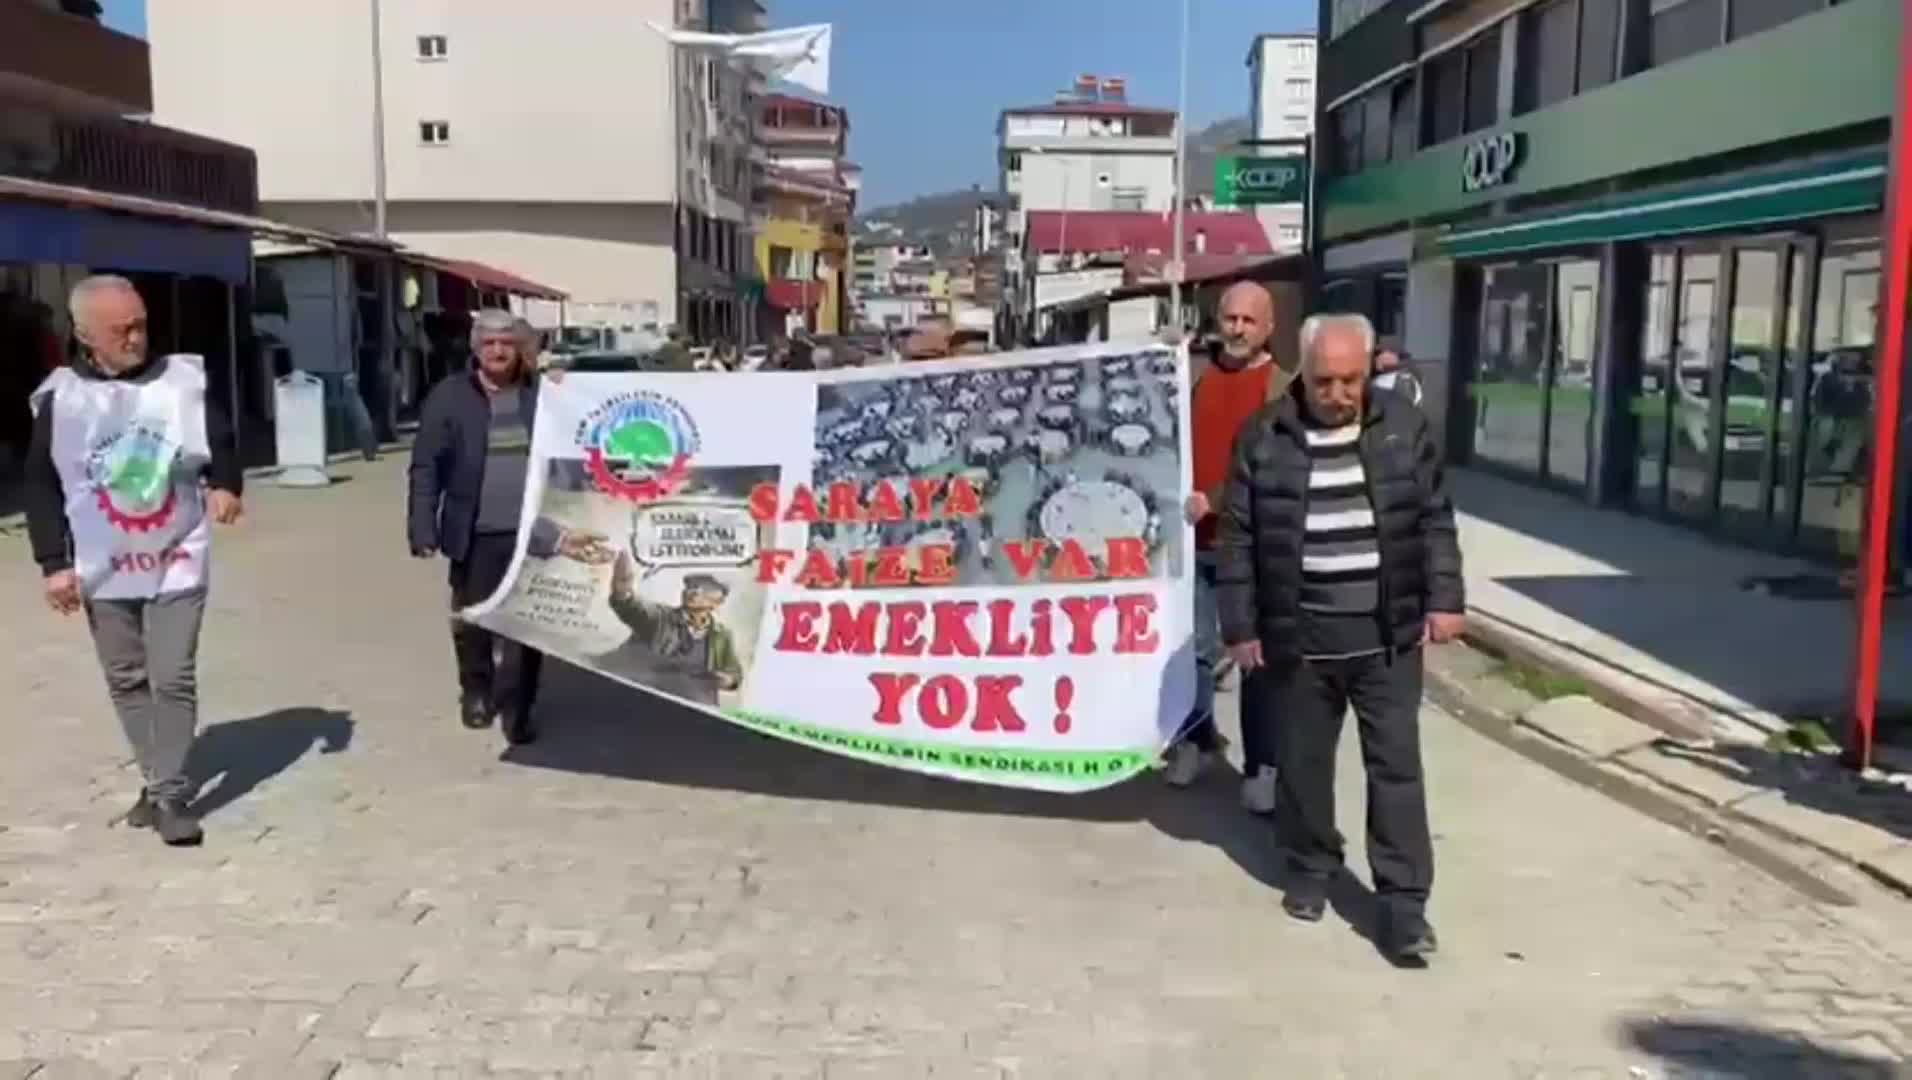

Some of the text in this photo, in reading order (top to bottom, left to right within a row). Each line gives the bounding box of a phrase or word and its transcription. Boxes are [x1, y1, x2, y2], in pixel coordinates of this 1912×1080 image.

[749, 474, 983, 523] SARAYA
[1003, 536, 1151, 580] VAR
[868, 672, 1075, 734] YOK !
